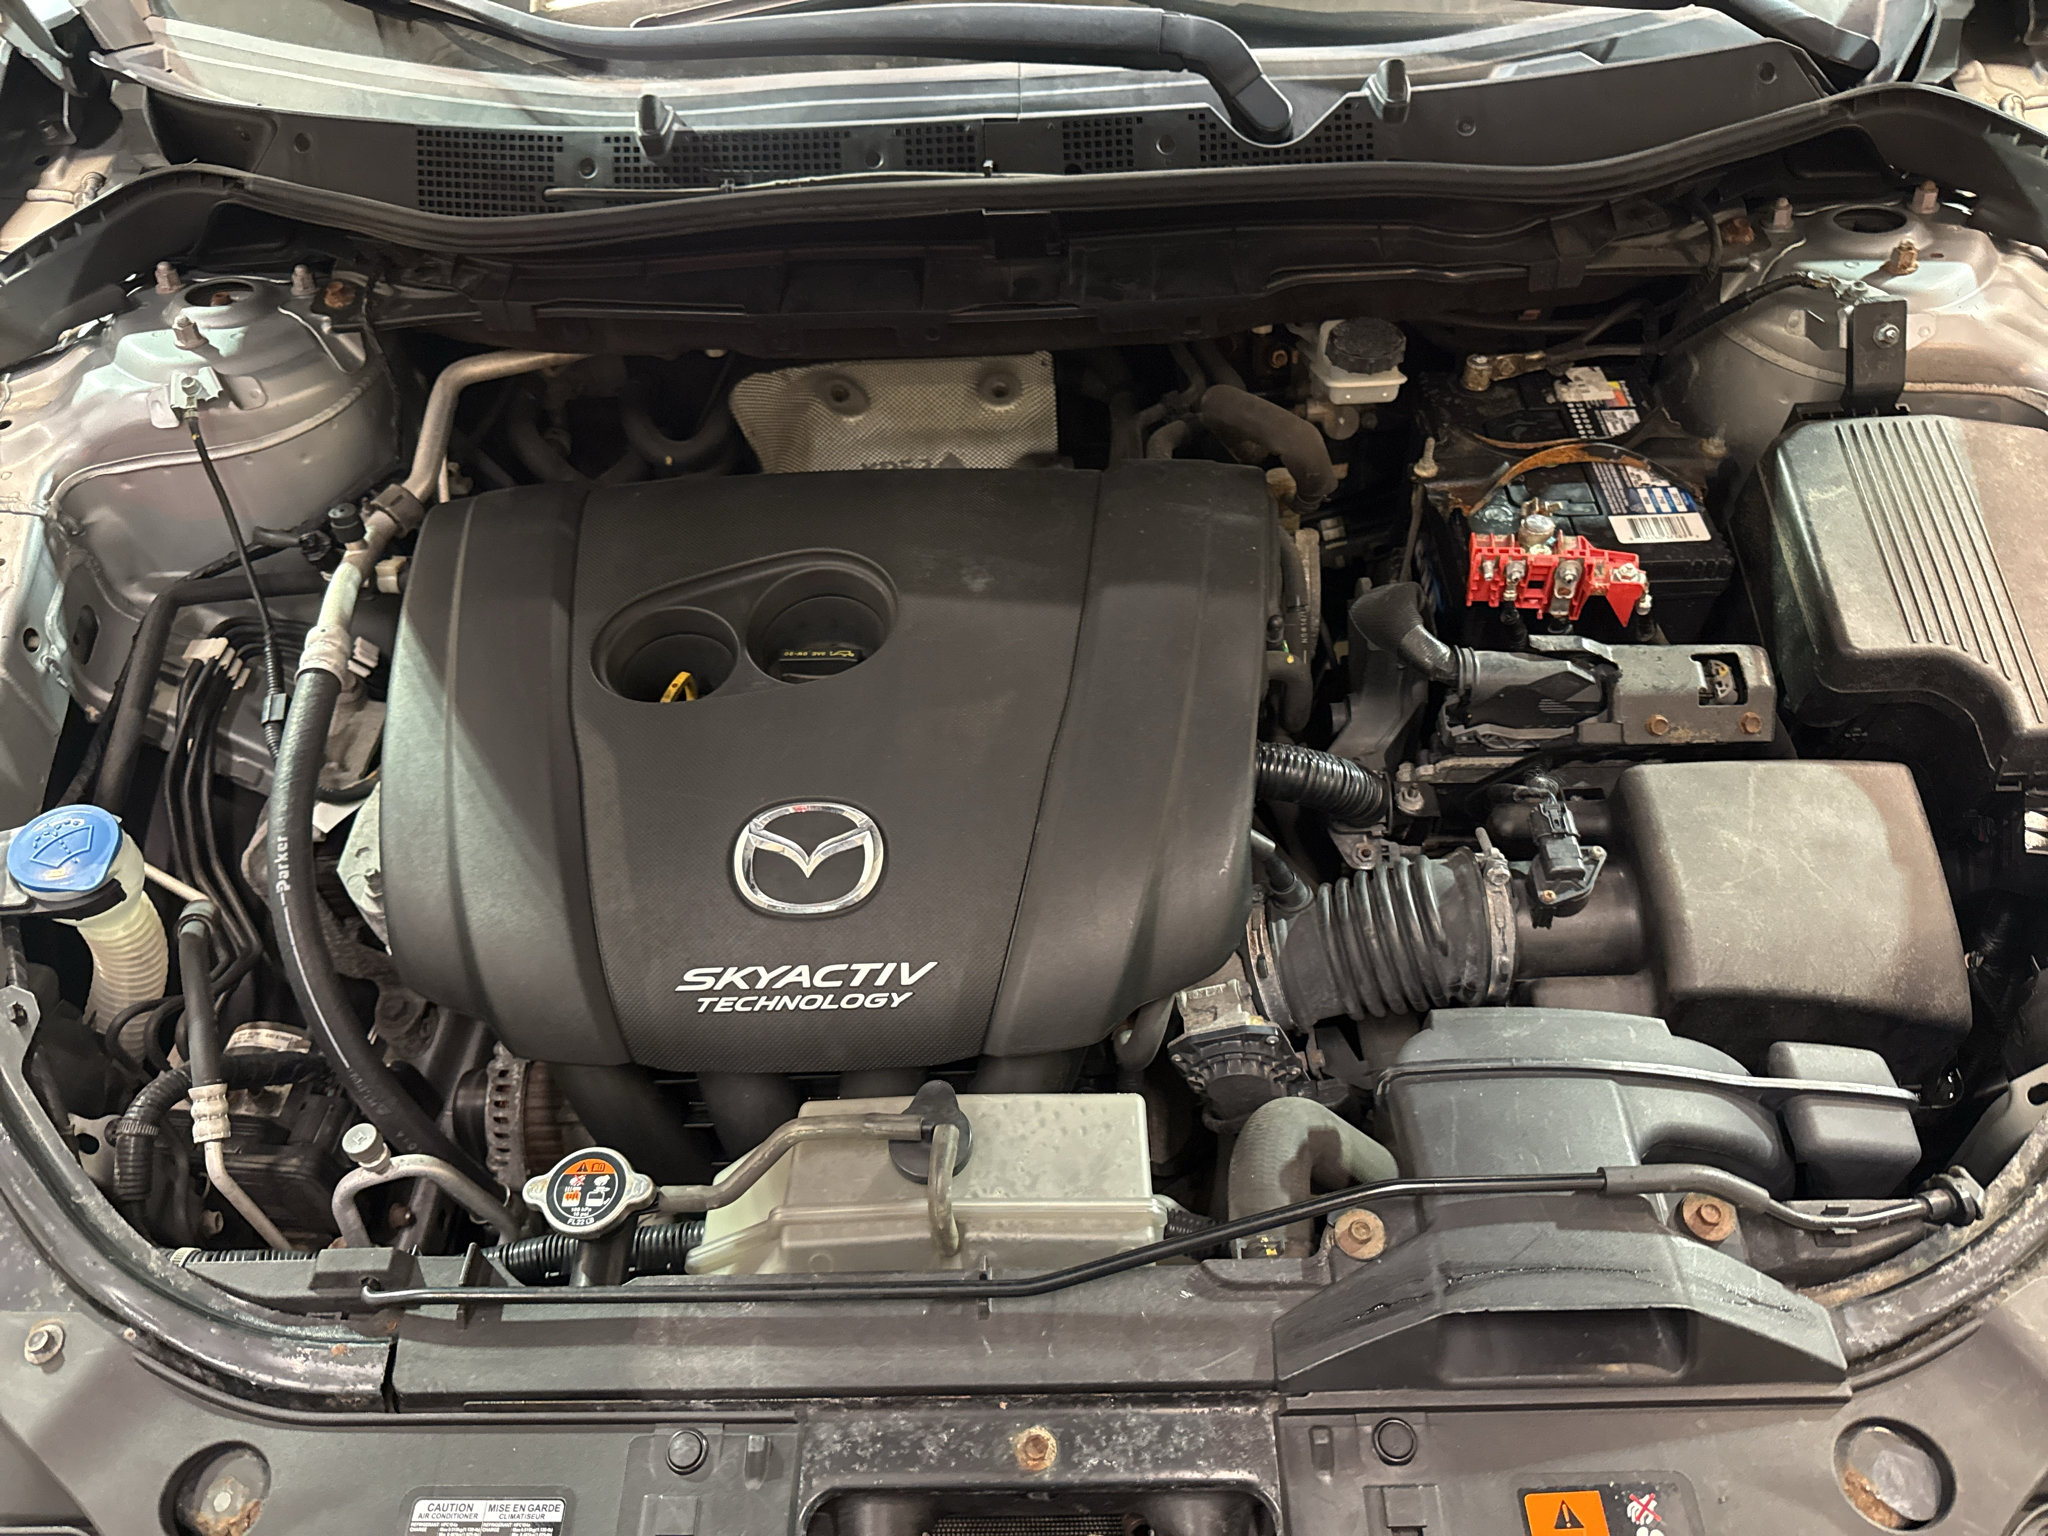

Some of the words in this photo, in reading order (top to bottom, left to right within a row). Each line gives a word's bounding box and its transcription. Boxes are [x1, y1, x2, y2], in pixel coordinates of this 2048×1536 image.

[274, 836, 291, 893] Parker
[675, 962, 938, 991] SKYACTIV
[697, 992, 913, 1013] TECHNOLOGY
[427, 1503, 474, 1512] CAUTION
[488, 1504, 511, 1512] MISE
[513, 1504, 526, 1512] EN
[528, 1504, 561, 1513] GARDE
